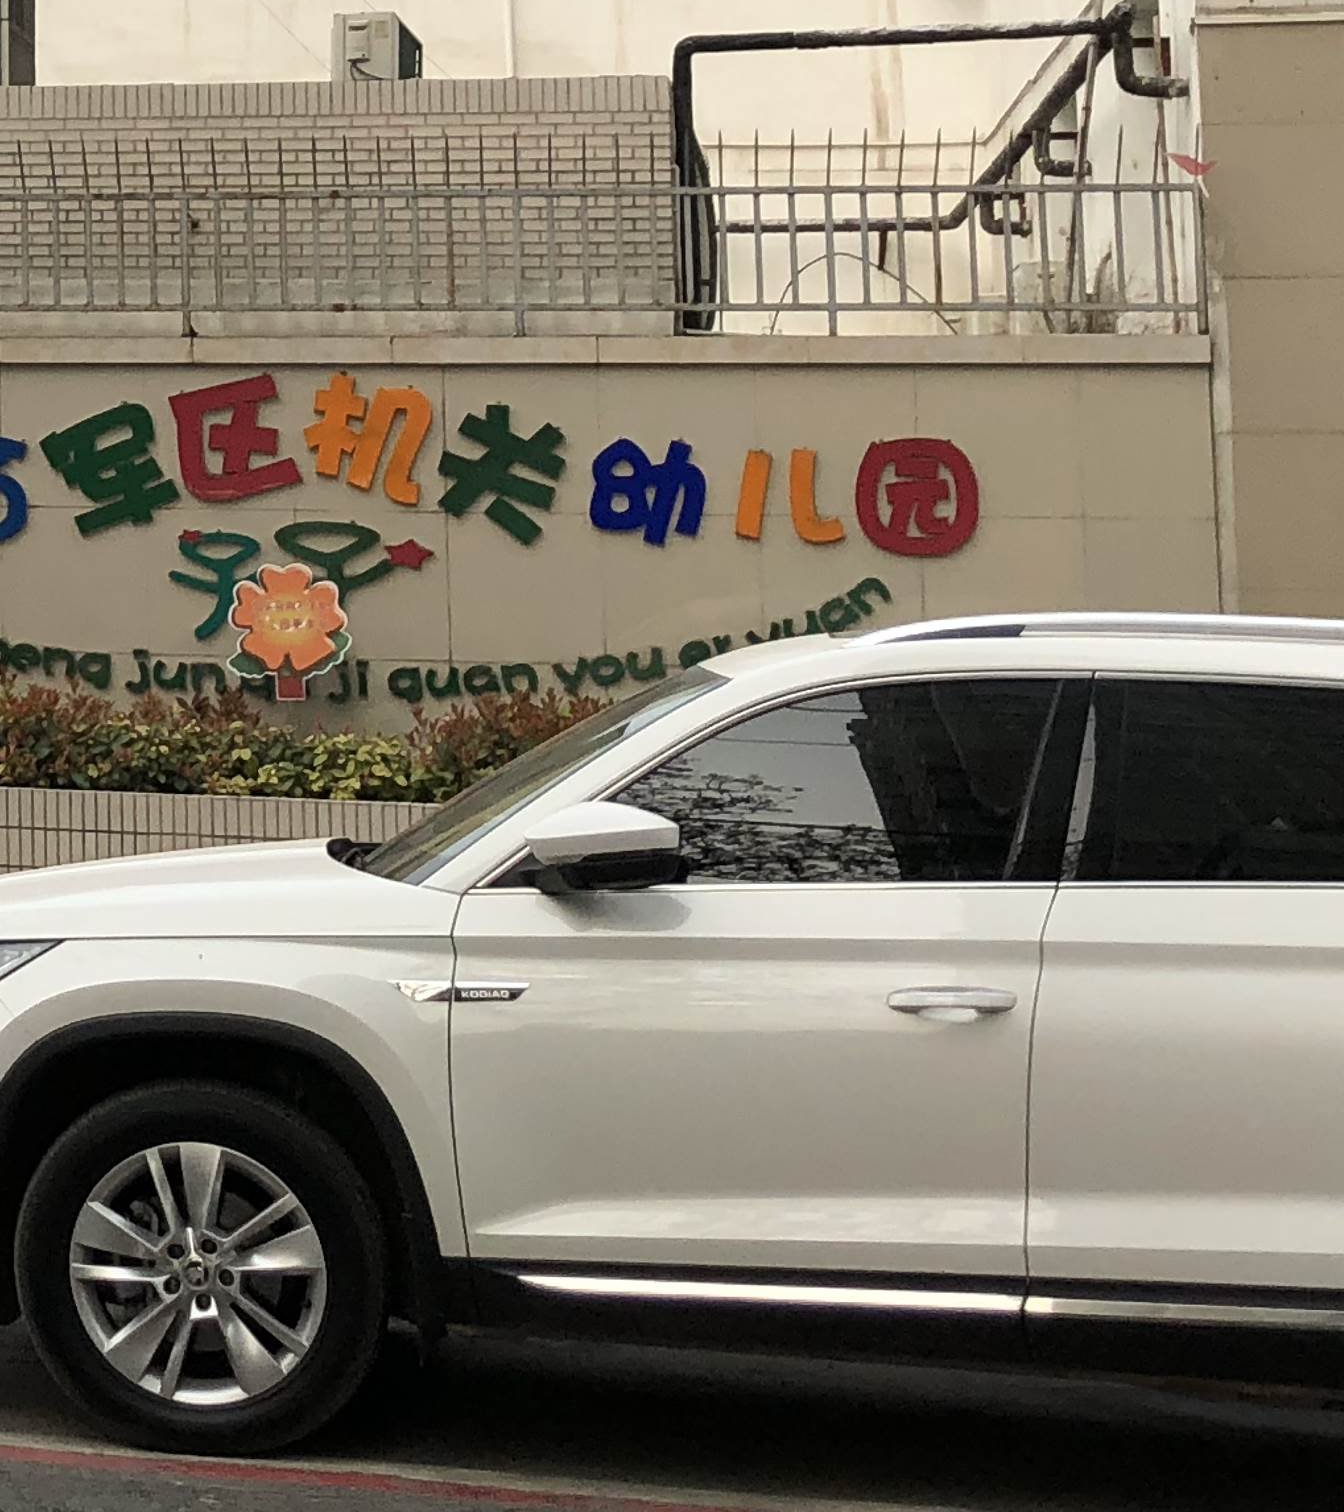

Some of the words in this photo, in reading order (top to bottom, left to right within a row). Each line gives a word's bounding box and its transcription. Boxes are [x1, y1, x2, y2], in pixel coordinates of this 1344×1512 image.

[388, 663, 538, 704] guan
[552, 646, 666, 696] you
[460, 989, 511, 999] KODIAQ
